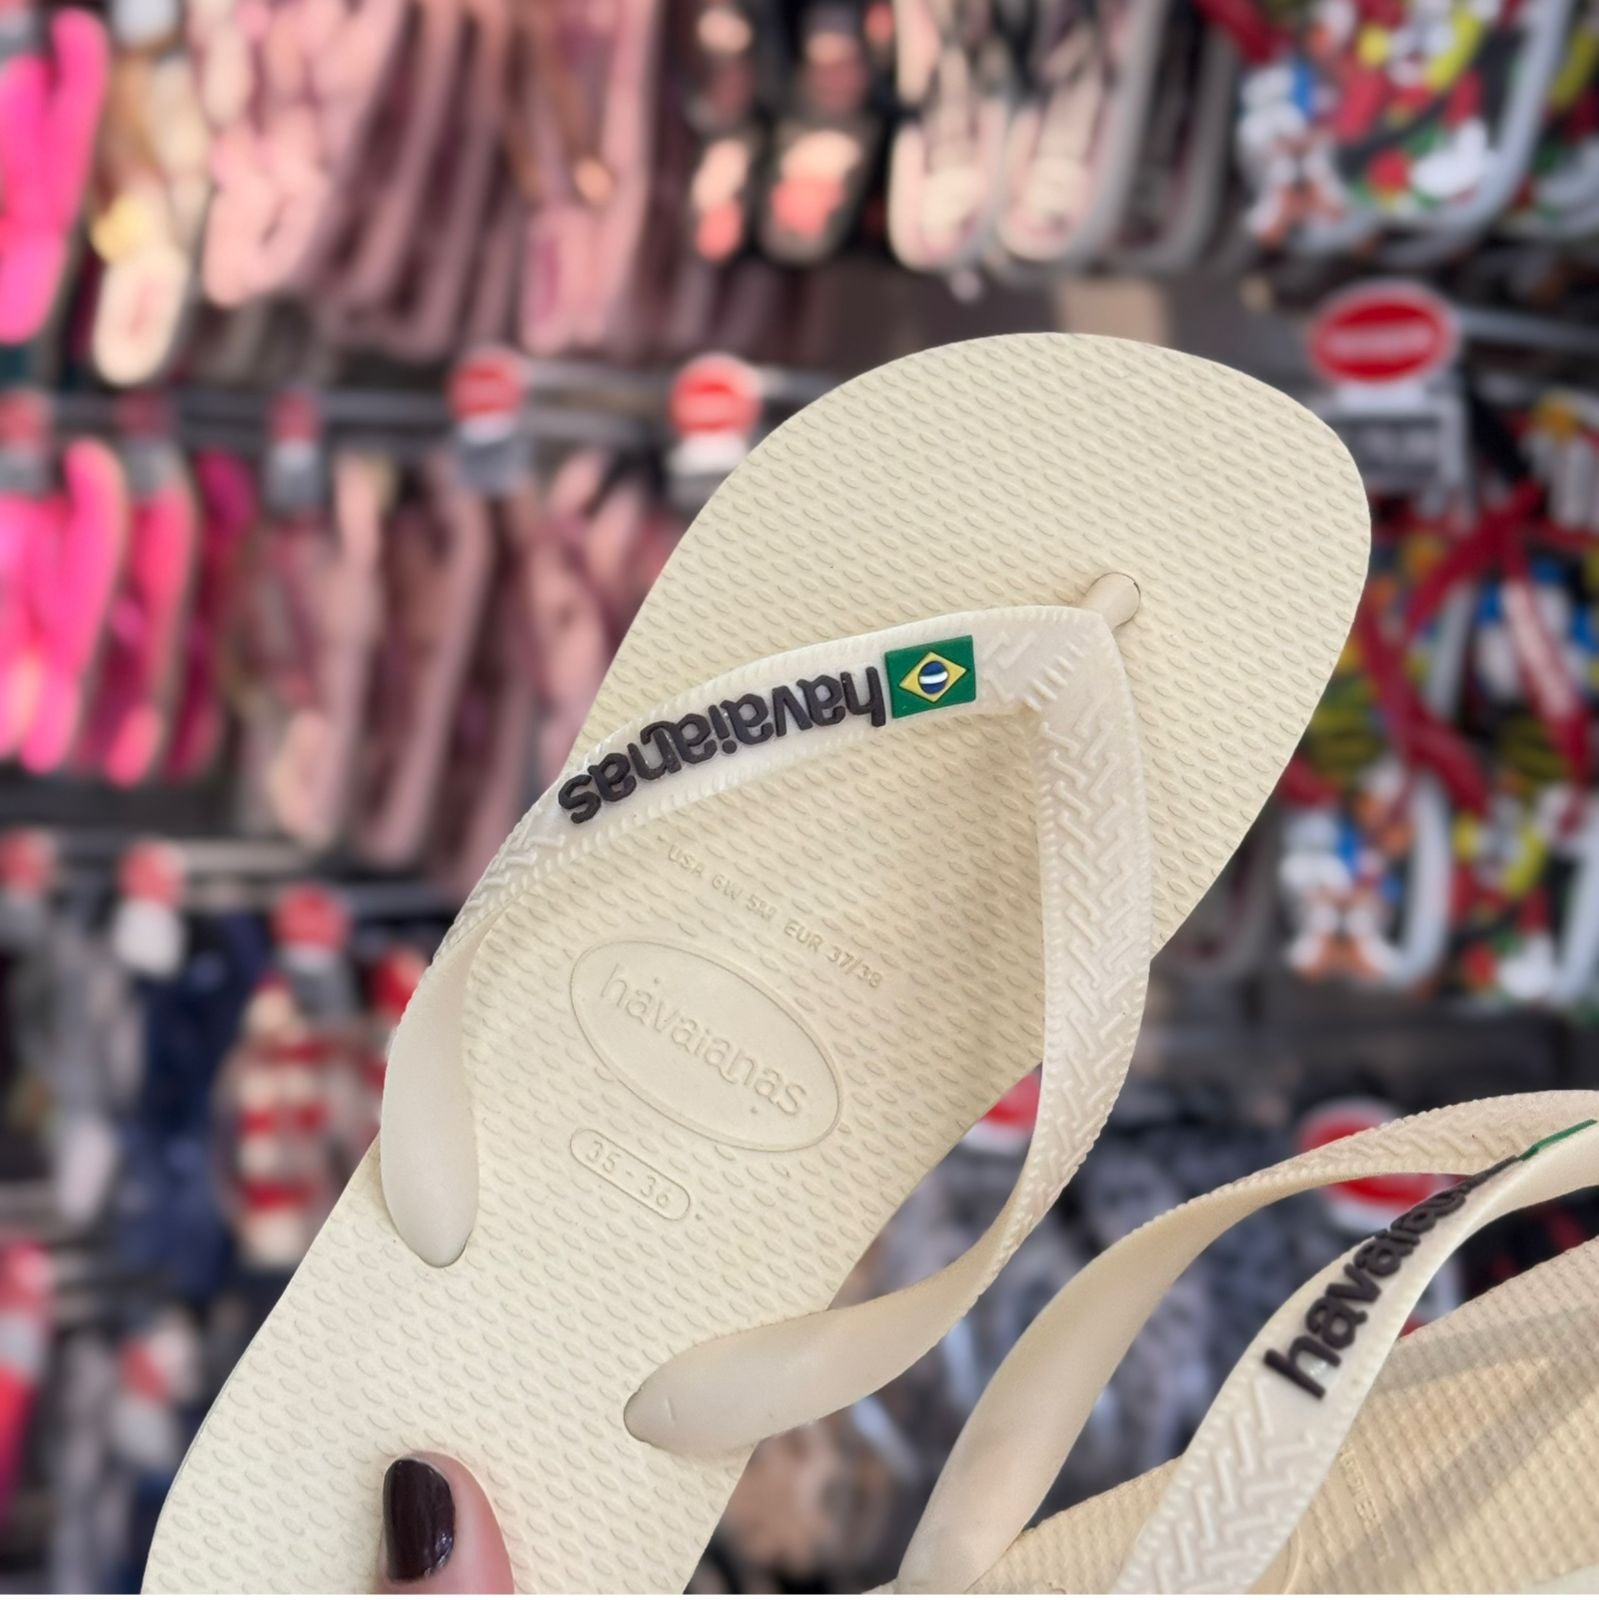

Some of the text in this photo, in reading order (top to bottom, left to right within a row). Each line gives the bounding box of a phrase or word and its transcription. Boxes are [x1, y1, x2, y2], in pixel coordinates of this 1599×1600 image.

[557, 665, 887, 825] havaianas
[667, 844, 705, 876] USA
[711, 873, 744, 900] 6W
[783, 917, 825, 952] EUR
[826, 945, 884, 989] 37/38
[599, 962, 808, 1118] havaianas
